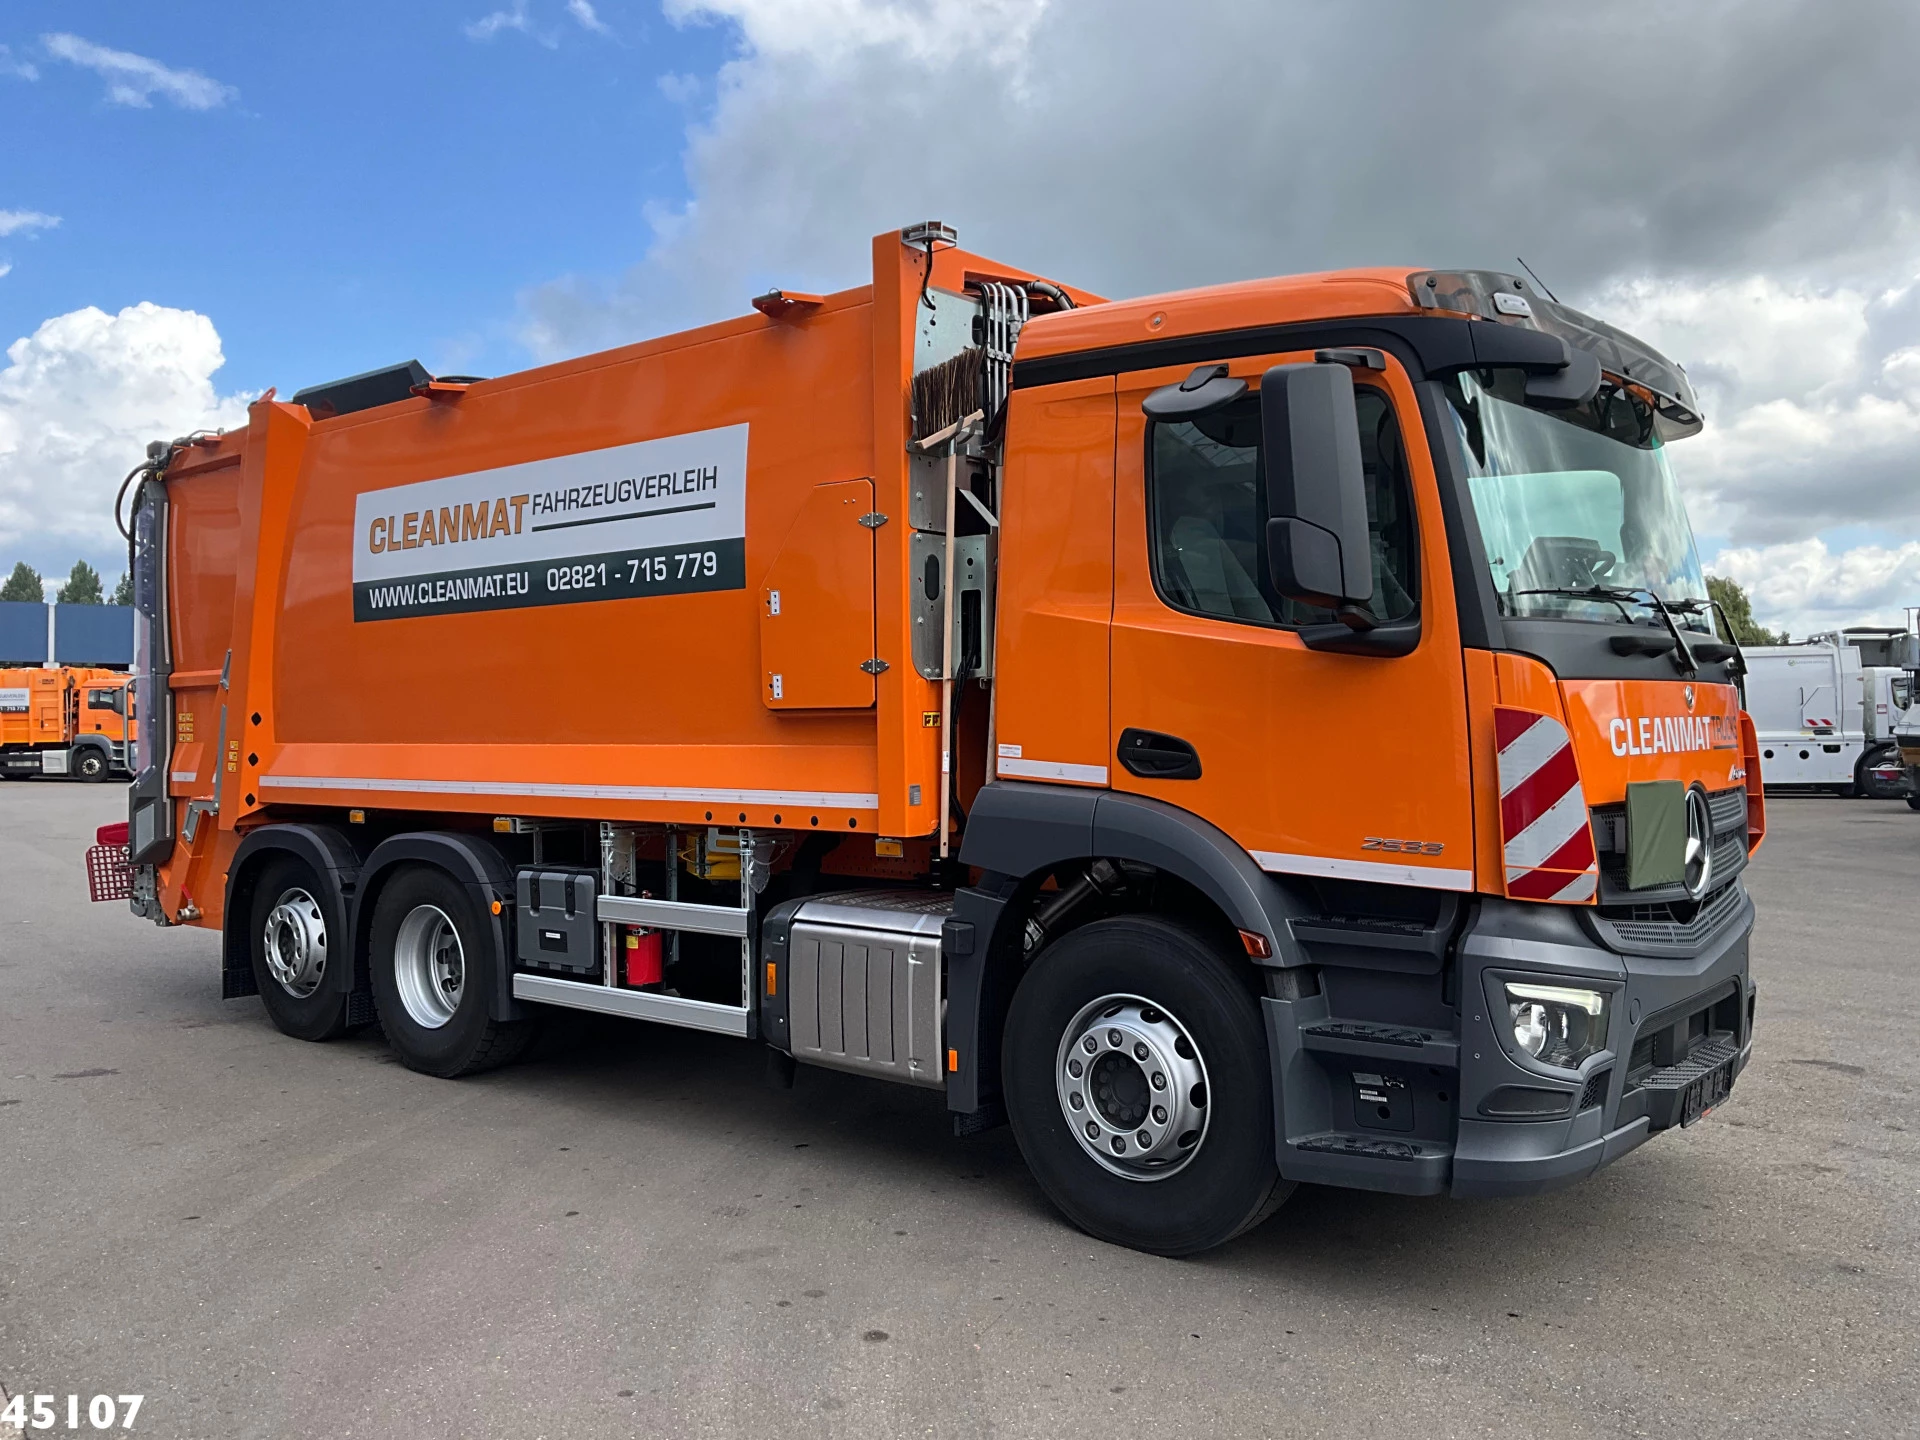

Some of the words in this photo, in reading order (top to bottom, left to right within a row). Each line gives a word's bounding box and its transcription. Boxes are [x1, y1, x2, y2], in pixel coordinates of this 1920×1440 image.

[369, 494, 529, 554] CLEANMAT
[532, 465, 717, 515] FAHRZEUGVERLEIH
[369, 571, 529, 609] WWW.CLEANMAT.EU
[547, 563, 606, 591] 02821
[627, 556, 667, 583] 715
[674, 551, 717, 579] 779
[1609, 716, 1710, 757] CLEANMAT
[1361, 836, 1445, 856] 2533
